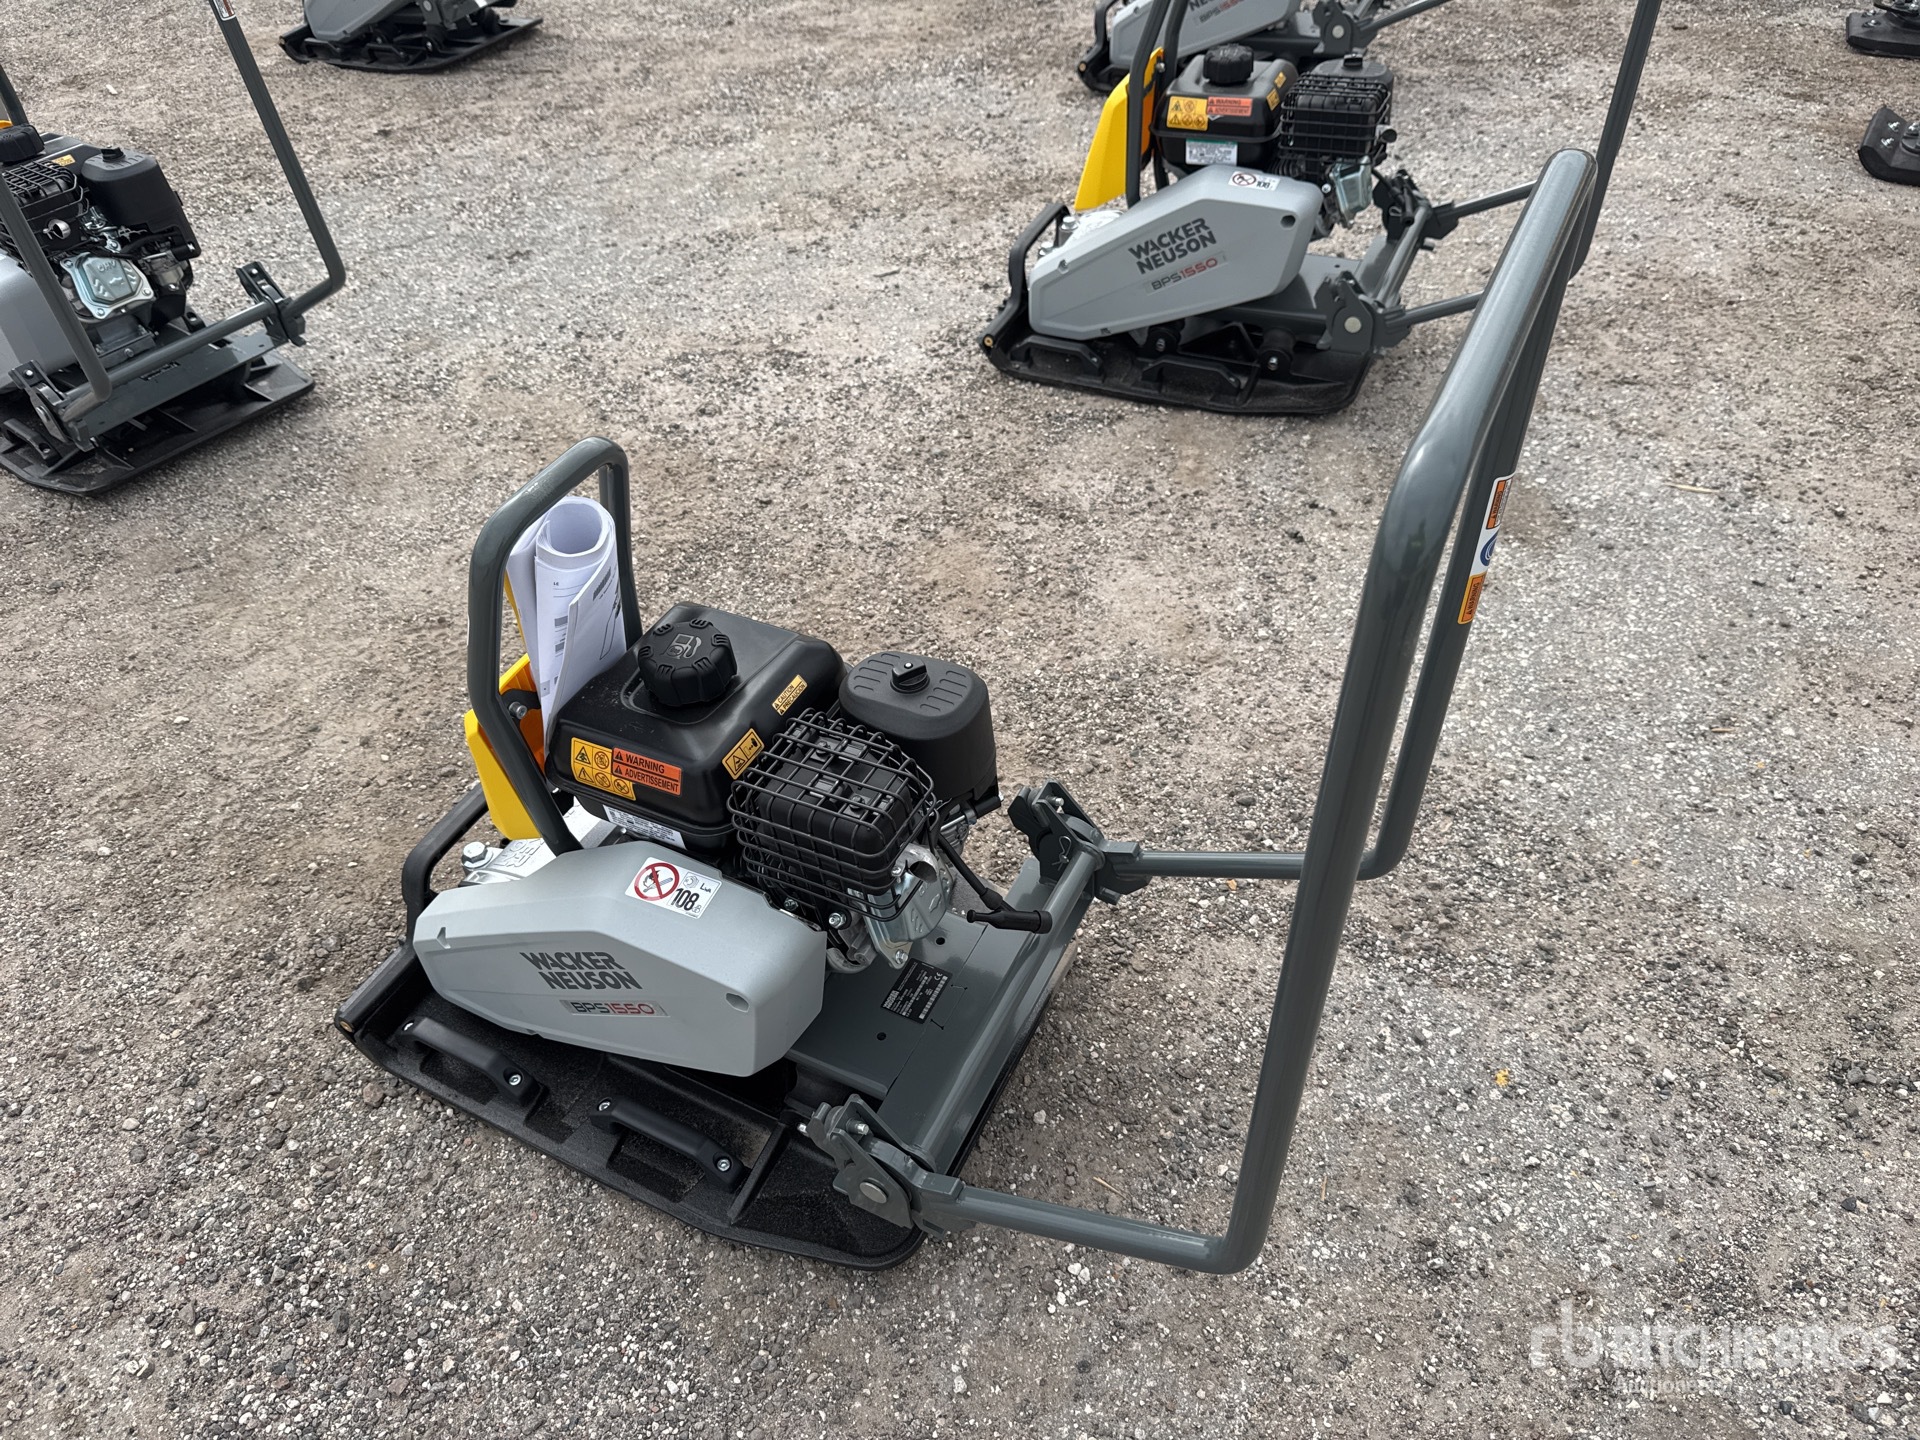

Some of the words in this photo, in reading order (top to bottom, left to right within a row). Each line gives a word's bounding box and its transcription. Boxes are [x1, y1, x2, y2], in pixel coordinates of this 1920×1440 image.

[1128, 218, 1210, 259] WACKER
[1136, 230, 1217, 275] NEUSON
[1151, 257, 1218, 290] BPS1550
[777, 684, 795, 704] CAUTION
[625, 753, 665, 774] WARNING
[625, 768, 679, 793] ADVERTISSEMENT
[670, 887, 700, 911] 108
[520, 952, 625, 970] WACKER
[538, 971, 643, 990] NEUSON
[570, 1001, 655, 1015] BPS1550
